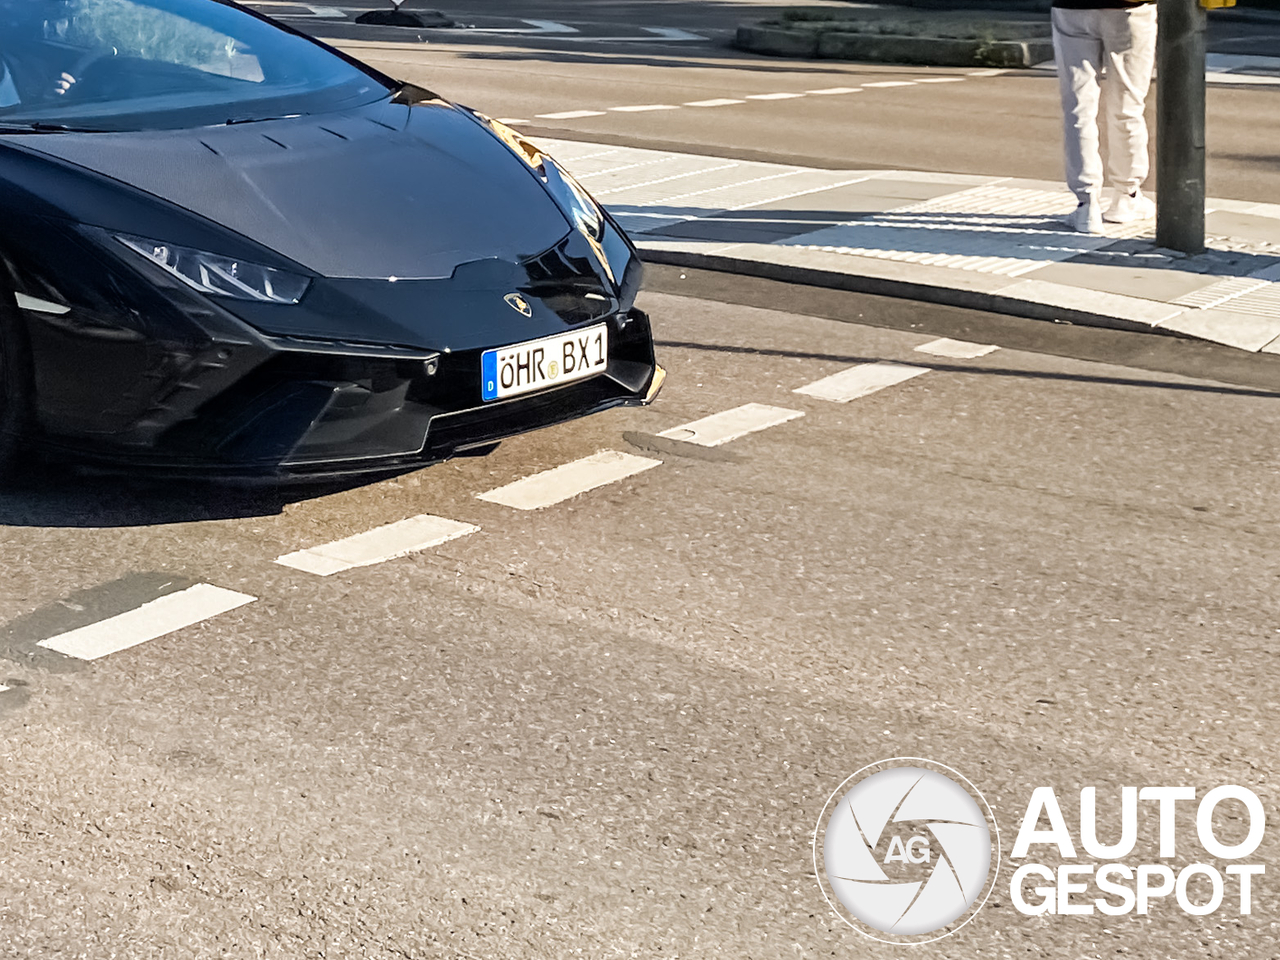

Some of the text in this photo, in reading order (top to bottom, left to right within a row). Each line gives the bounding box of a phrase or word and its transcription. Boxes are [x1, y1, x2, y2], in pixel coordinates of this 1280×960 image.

[488, 332, 605, 391] D ÖHR BX 1
